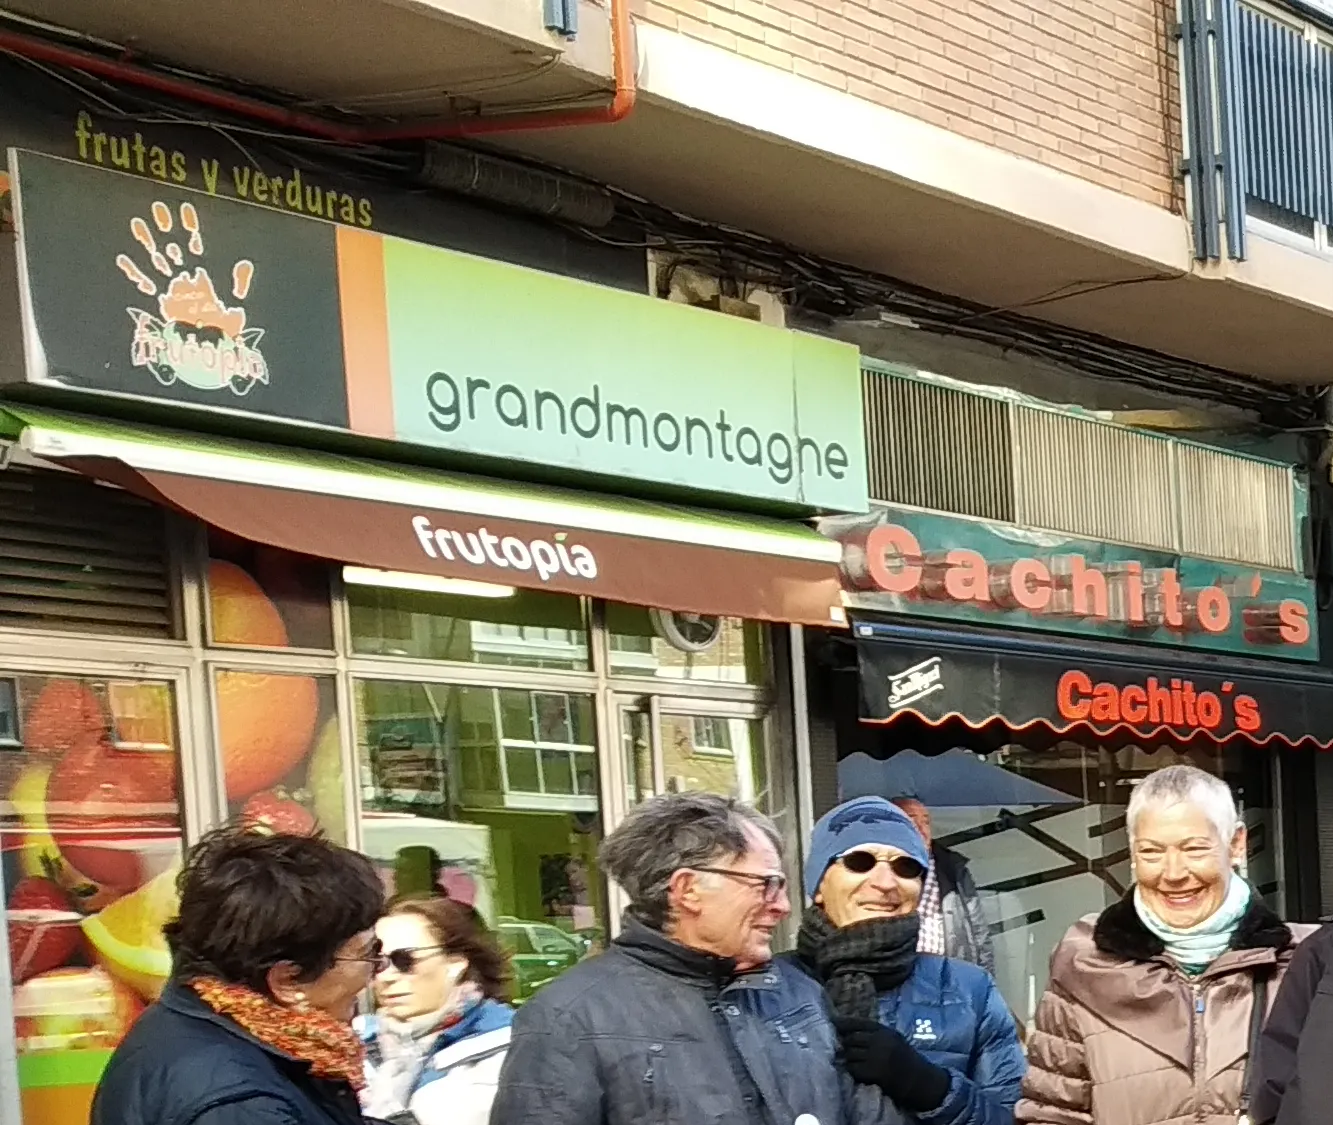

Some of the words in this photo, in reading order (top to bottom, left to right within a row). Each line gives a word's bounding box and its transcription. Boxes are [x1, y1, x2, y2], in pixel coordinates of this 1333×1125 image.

[75, 109, 187, 184] frutas
[200, 155, 219, 197] y
[233, 162, 373, 227] verduras
[426, 371, 849, 484] grandmontagne
